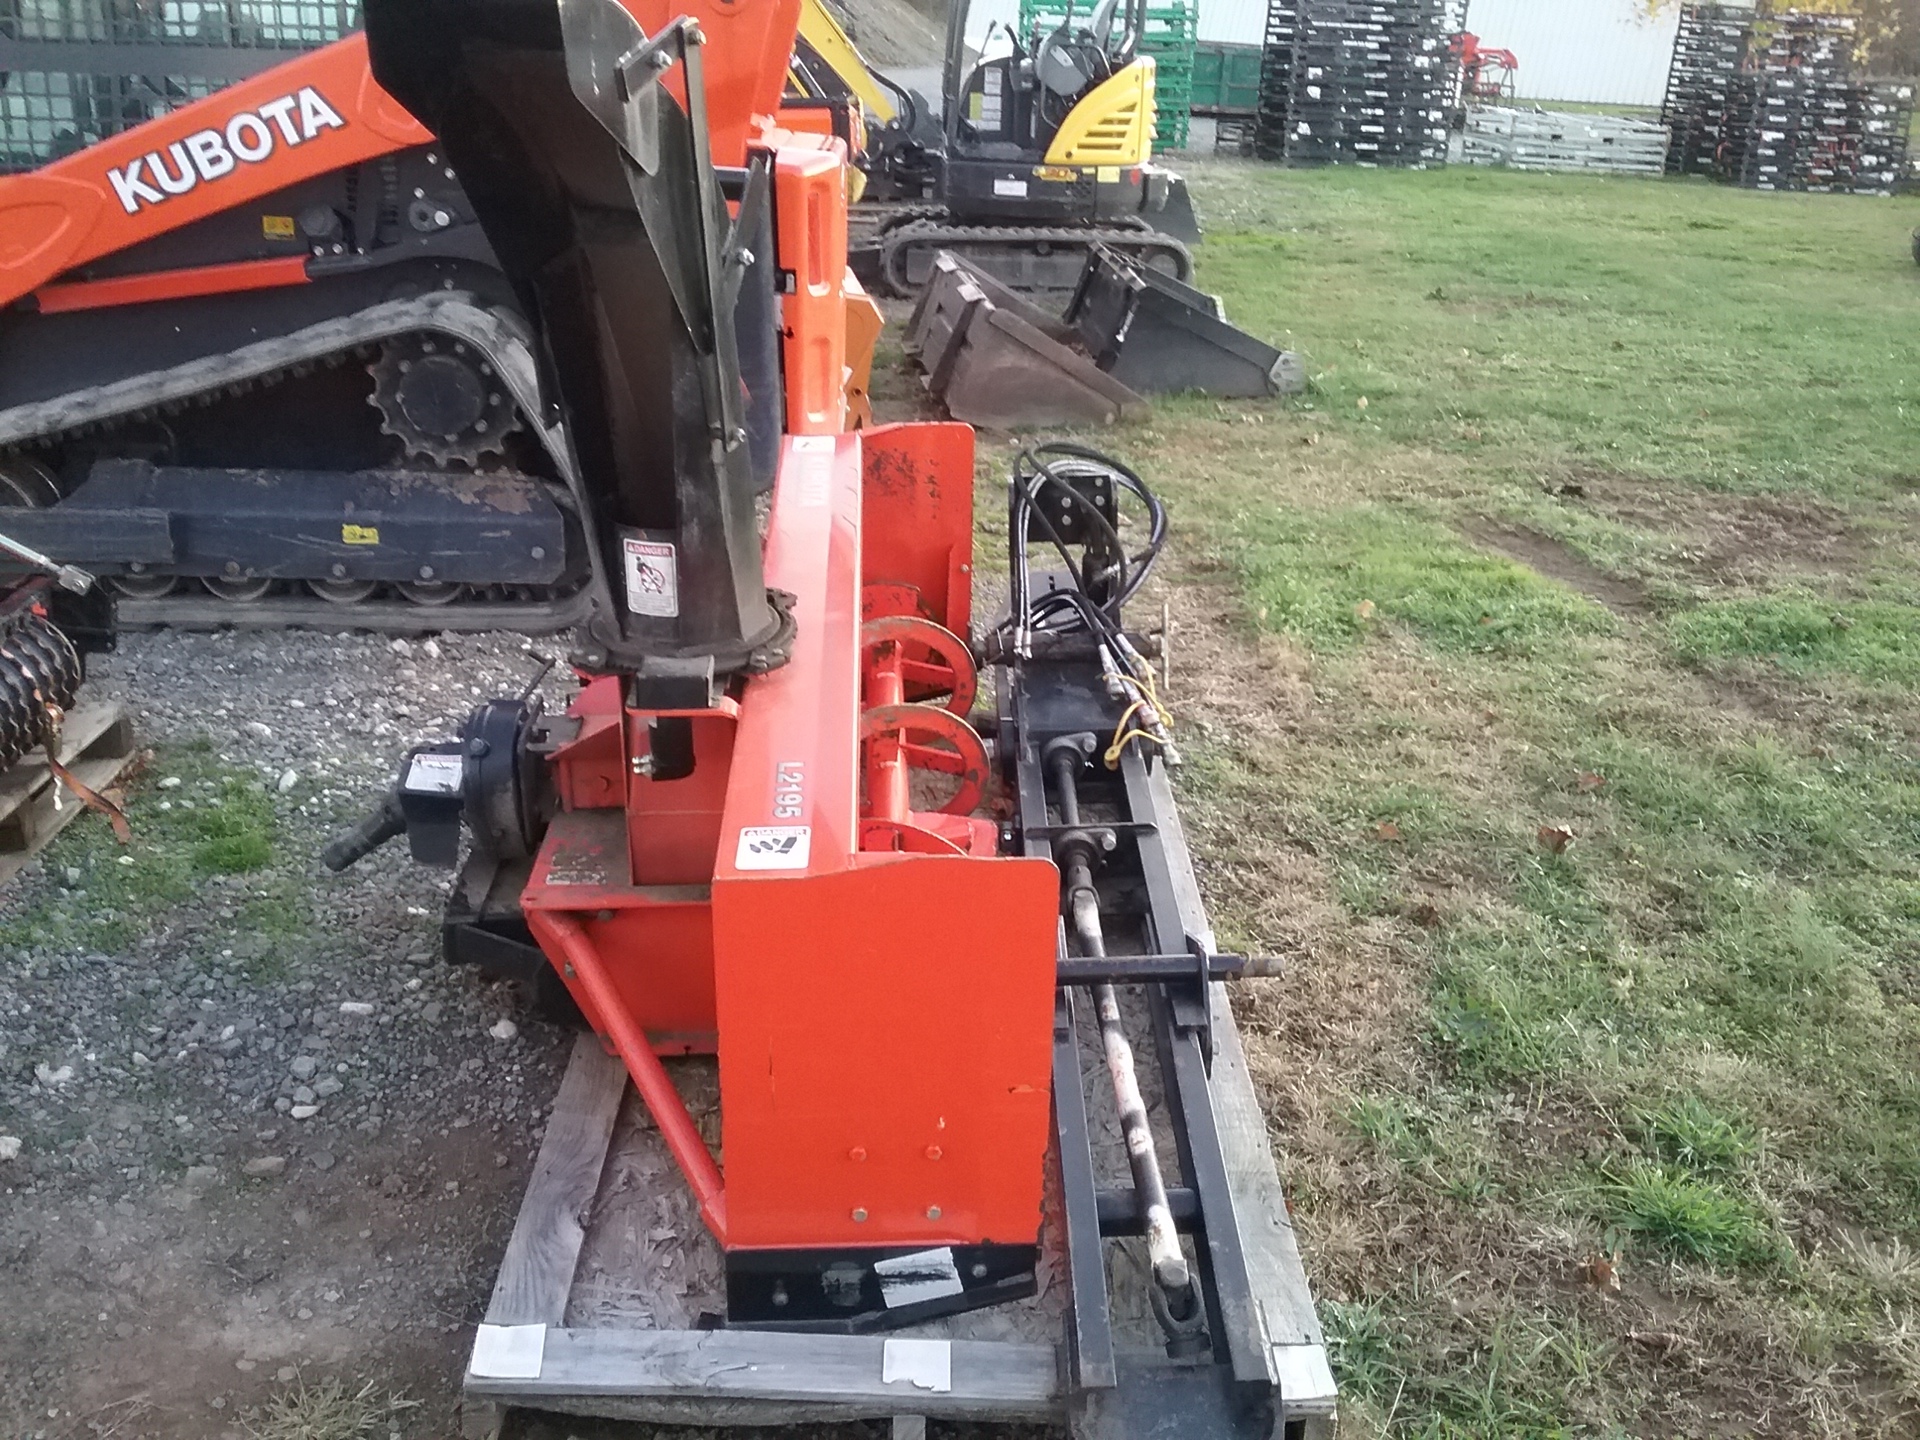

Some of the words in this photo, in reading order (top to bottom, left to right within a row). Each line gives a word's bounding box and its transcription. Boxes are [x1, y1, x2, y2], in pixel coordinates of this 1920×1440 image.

[106, 86, 344, 214] KUBOTA
[634, 544, 670, 556] DANGER
[773, 762, 804, 818] L2195
